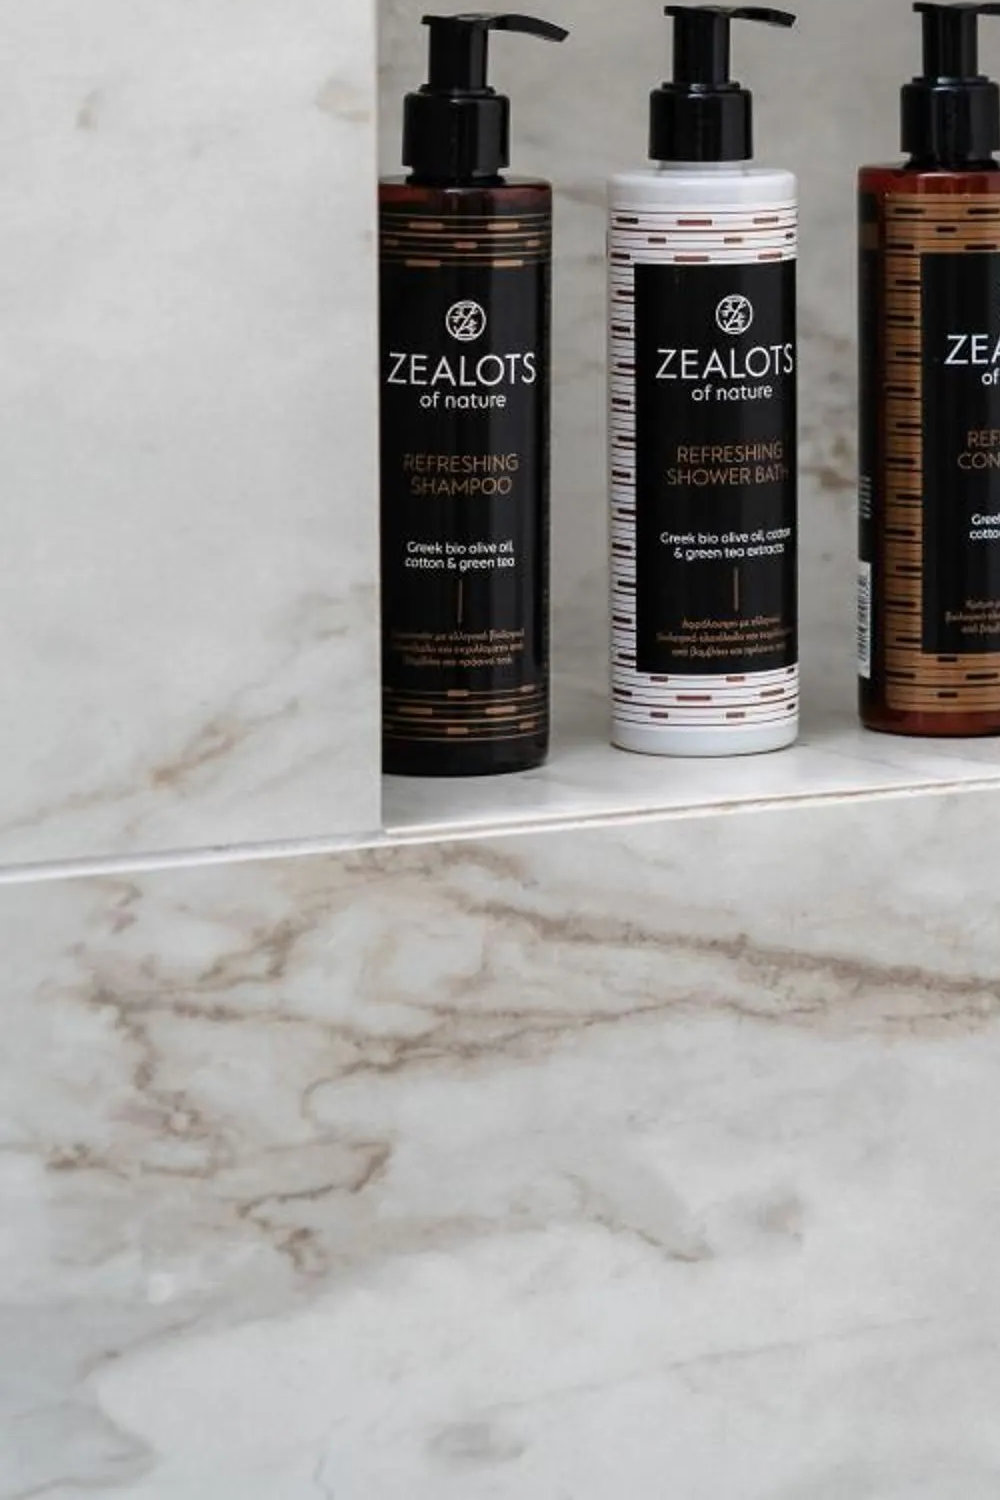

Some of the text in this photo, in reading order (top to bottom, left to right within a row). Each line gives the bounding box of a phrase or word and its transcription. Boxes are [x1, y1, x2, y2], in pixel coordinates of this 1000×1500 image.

[387, 351, 537, 387] ZEALOTS
[656, 343, 793, 379] ZEALOTS
[981, 367, 1000, 385] of
[419, 391, 507, 409] of nature
[691, 384, 773, 401] of nature
[677, 441, 783, 463] REFRESHING
[402, 453, 520, 473] REFRESHING
[410, 476, 513, 495] SHAMPOO
[667, 467, 750, 486] SHOWER
[659, 531, 695, 545] Greek
[698, 531, 718, 545] bio
[721, 531, 749, 544] olive
[407, 540, 443, 554] Greek
[445, 541, 467, 555] bio
[468, 541, 497, 555] olive
[673, 547, 683, 559] &
[685, 548, 722, 562] green
[724, 547, 745, 558] tea
[404, 557, 445, 570] cotton
[447, 557, 457, 569] &
[458, 558, 495, 573] green
